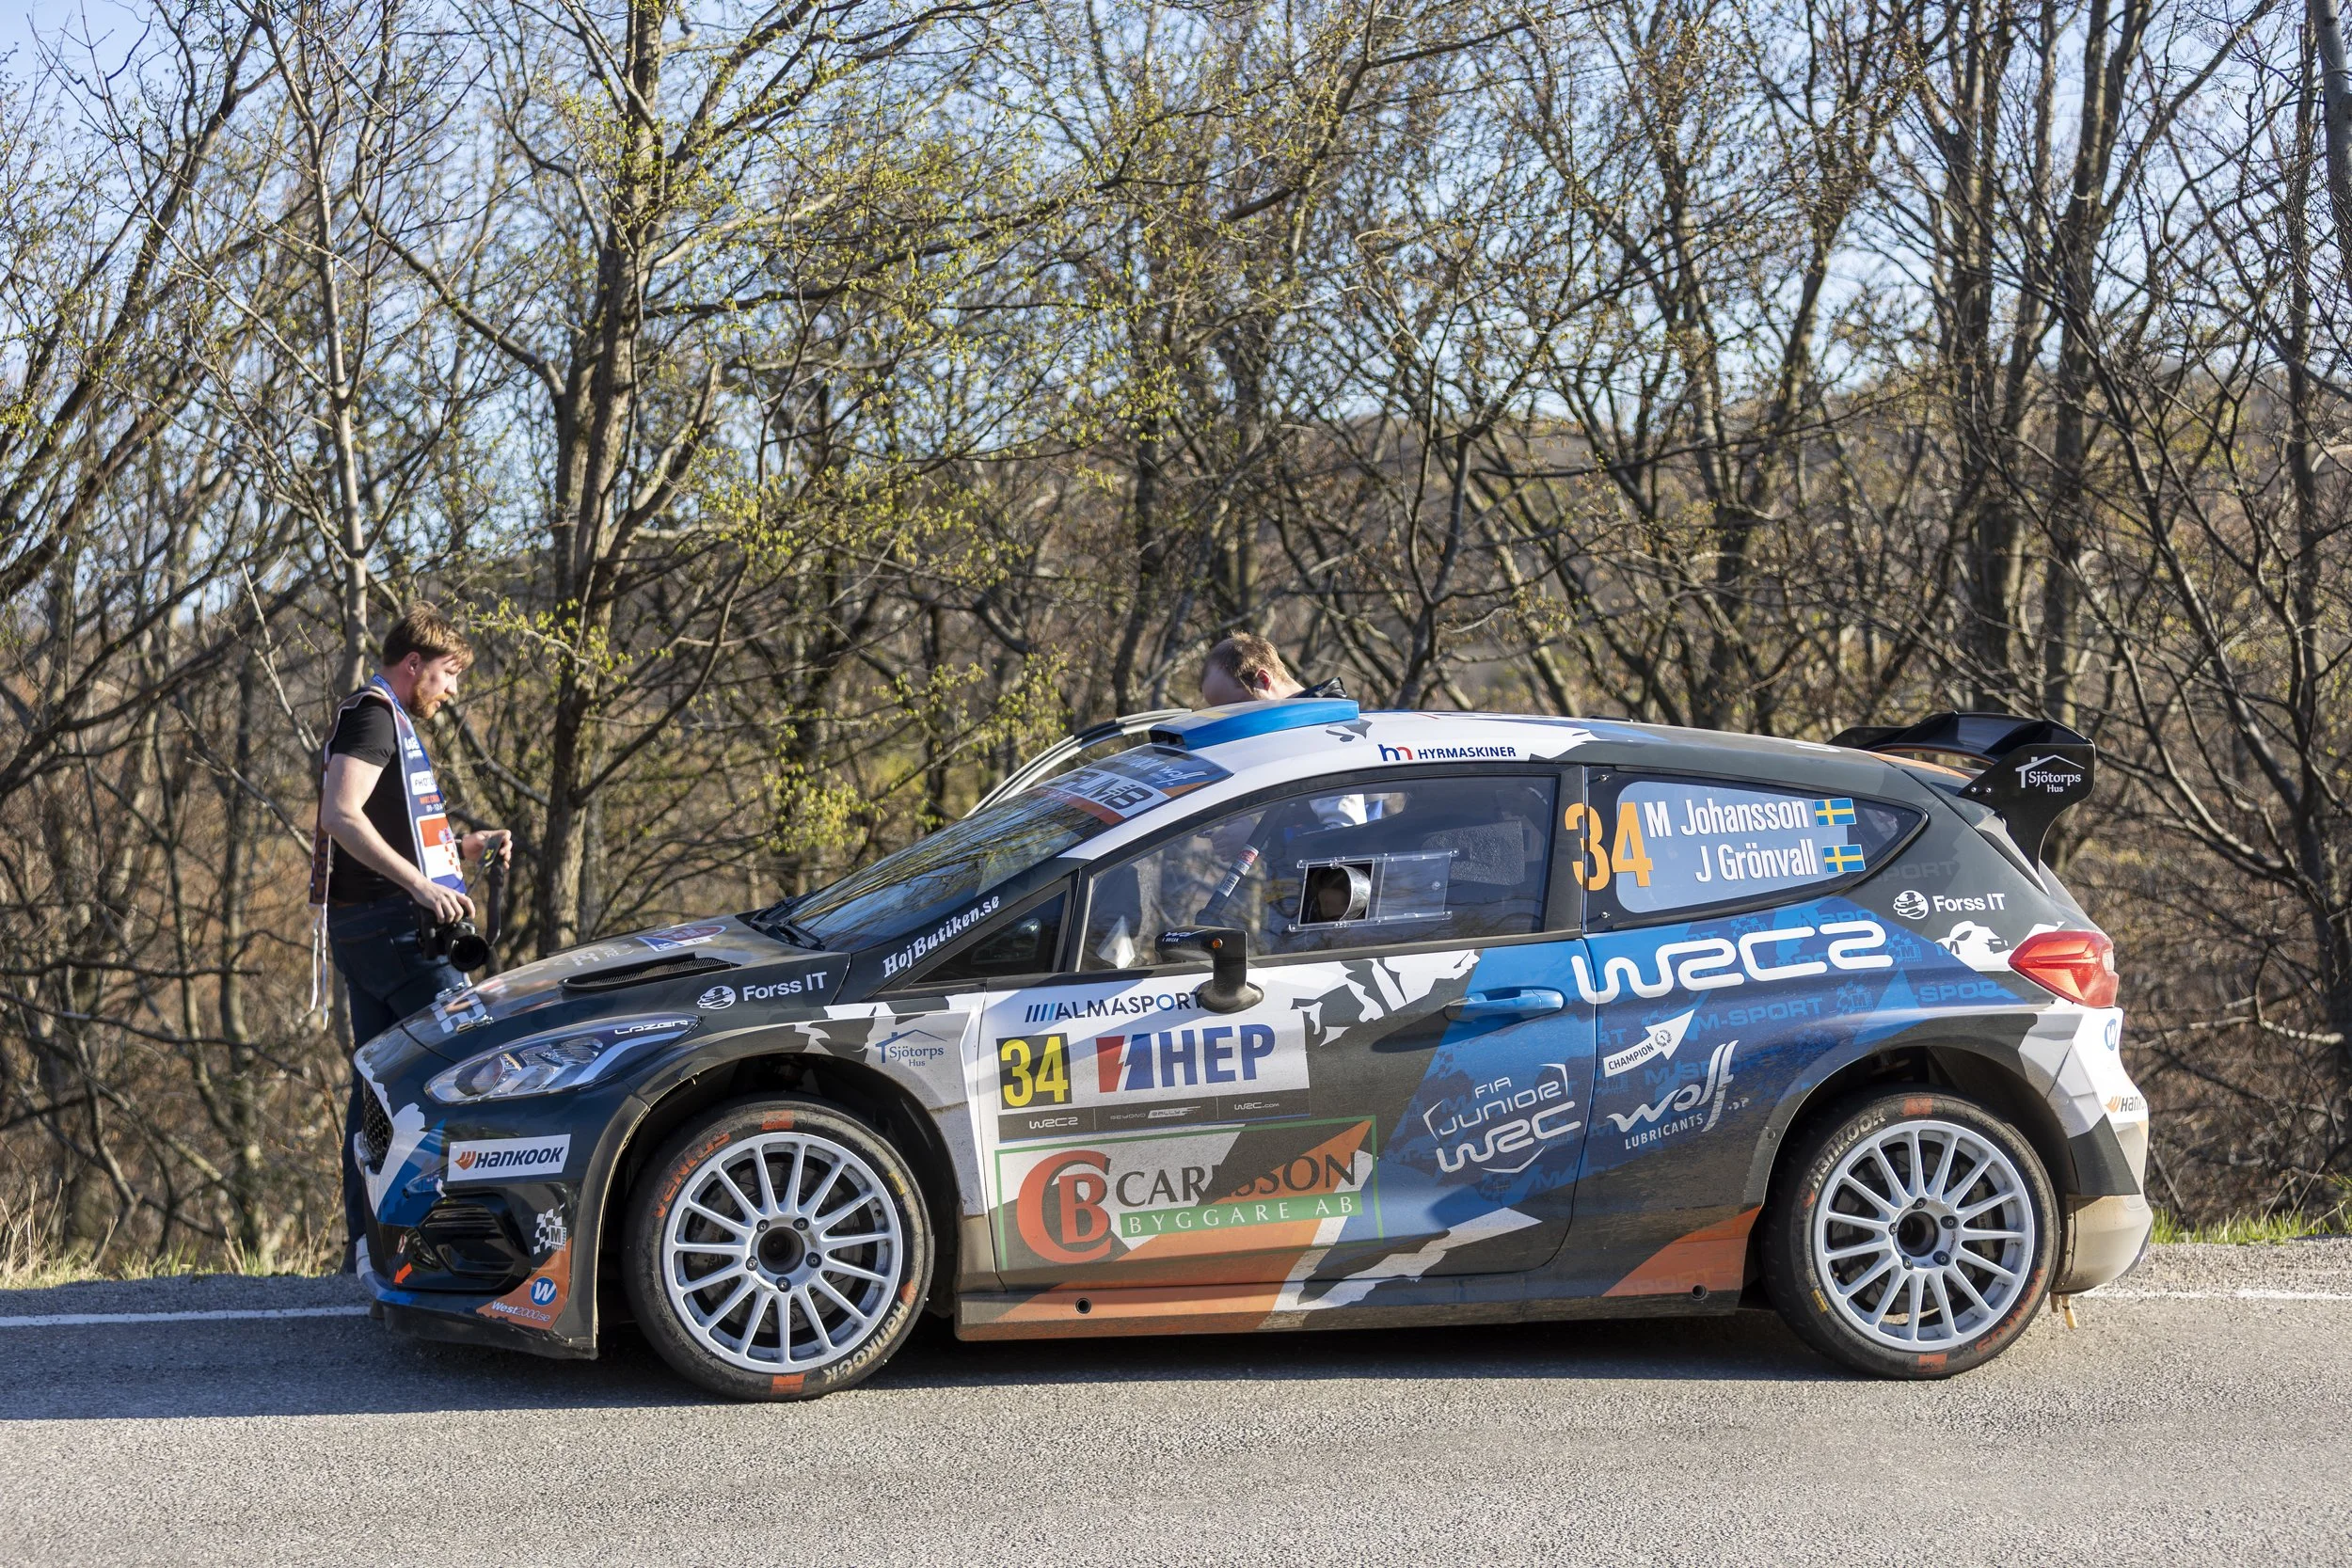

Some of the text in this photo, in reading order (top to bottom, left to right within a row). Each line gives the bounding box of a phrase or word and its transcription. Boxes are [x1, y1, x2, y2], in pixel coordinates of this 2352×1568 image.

[1417, 746, 1517, 759] HYRMASKINER
[2028, 770, 2082, 787] Sjötorps
[2046, 784, 2064, 793] Hus
[1644, 797, 1810, 839] M Johansson
[1565, 801, 1654, 892] 34
[1695, 838, 1819, 883] J Grönvall
[1932, 893, 2006, 912] Forss IT
[882, 895, 1000, 978] HojButiken.se
[1570, 920, 1894, 1005] WRC2
[742, 972, 828, 1003] Forss IT
[613, 1020, 690, 1036] LAZER
[889, 1046, 945, 1061] Sjötorps
[908, 1058, 926, 1068] Hus
[1158, 1023, 1277, 1088] HEP
[1608, 1043, 1655, 1070] CHAMPION
[1000, 1036, 1069, 1107] 34
[1474, 1077, 1512, 1099] FIA
[1028, 1117, 1079, 1130] WRC2
[1438, 1080, 1563, 1136] JUNIOR
[1436, 1101, 1581, 1173] WRC
[1625, 1114, 1704, 1150] LUBRICANTS
[1129, 1195, 1353, 1235] BYGGARE AB
[533, 1281, 557, 1302] W
